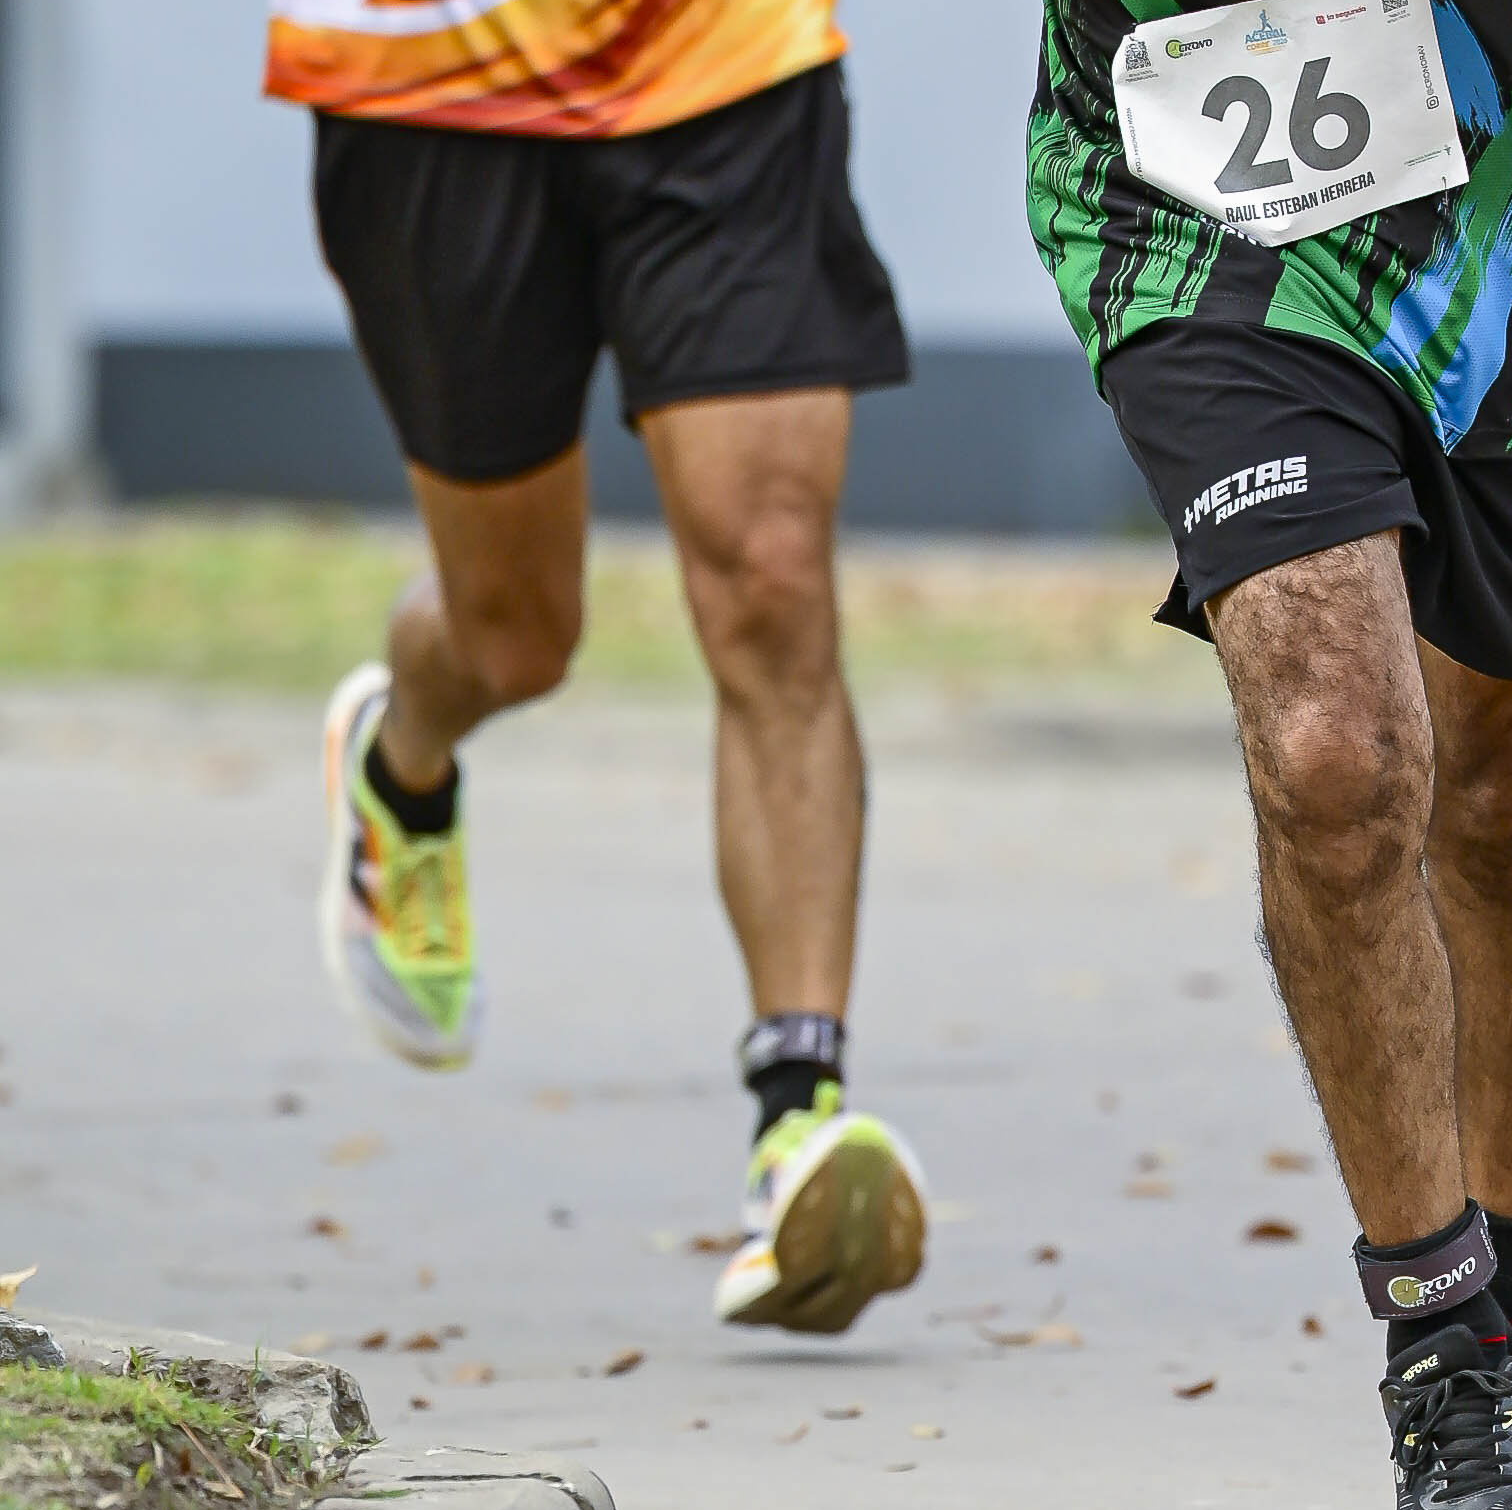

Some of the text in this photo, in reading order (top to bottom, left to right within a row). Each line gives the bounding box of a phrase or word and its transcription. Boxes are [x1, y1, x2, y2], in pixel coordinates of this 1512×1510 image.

[1201, 56, 1371, 194] 26
[1225, 171, 1376, 223] RAUL ESTEBAN HERRERA
[1215, 478, 1308, 526] RUNNING
[1416, 1292, 1446, 1307] RAV
